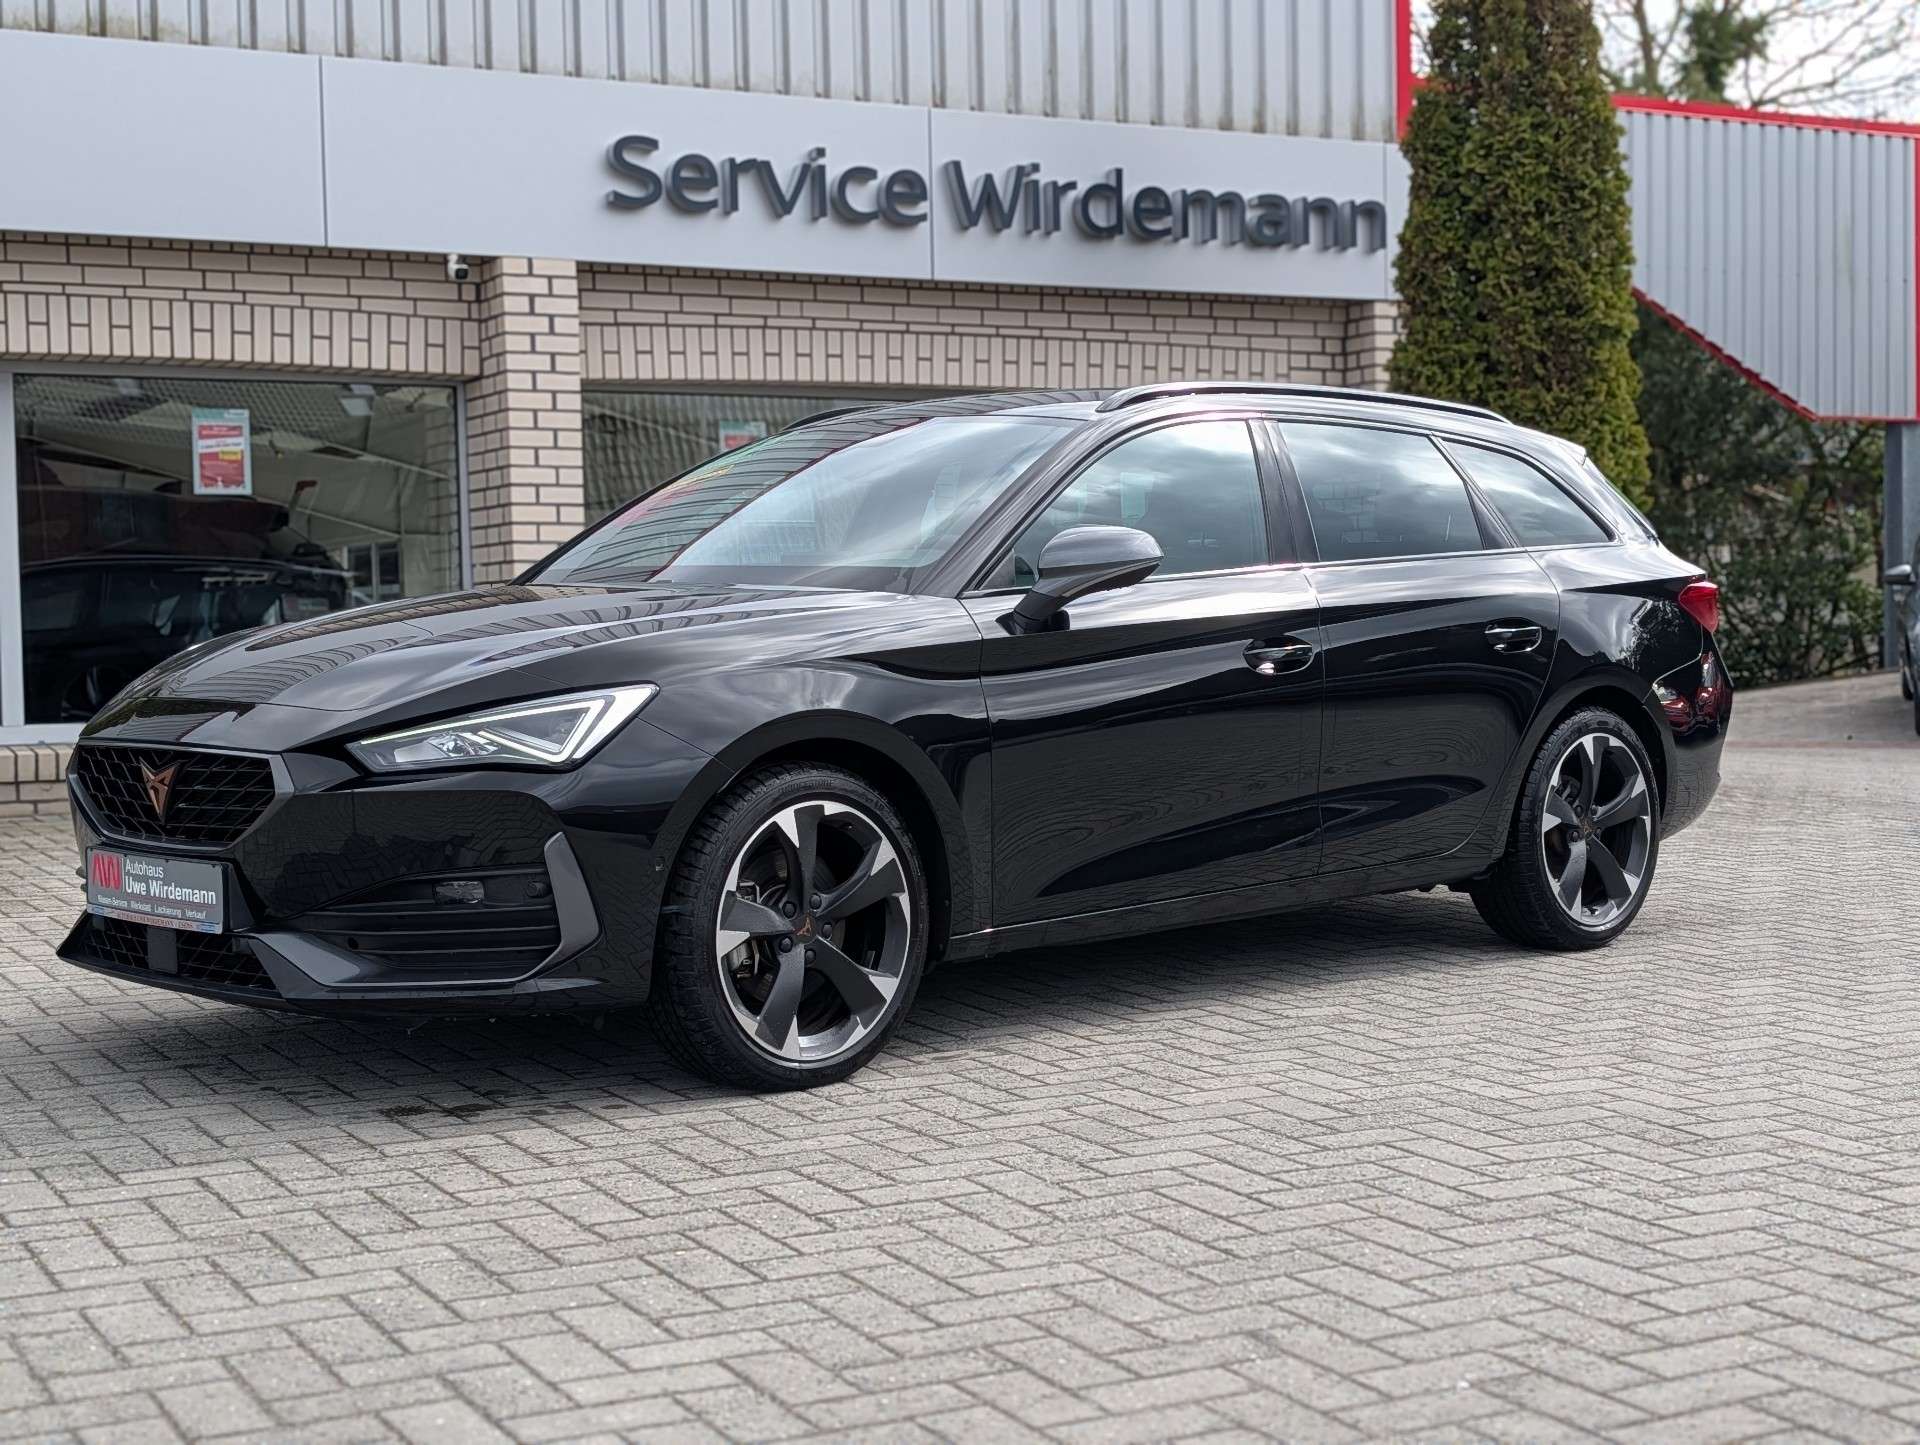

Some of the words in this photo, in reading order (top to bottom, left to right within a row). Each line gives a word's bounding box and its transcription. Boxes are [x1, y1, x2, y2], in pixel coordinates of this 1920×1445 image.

[605, 134, 929, 228] Service
[943, 158, 1388, 252] Wirdemann
[125, 859, 164, 878] Autohaus
[125, 875, 147, 895] Uwe
[149, 879, 217, 905] Wirdemann
[185, 908, 207, 919] Verkauf
